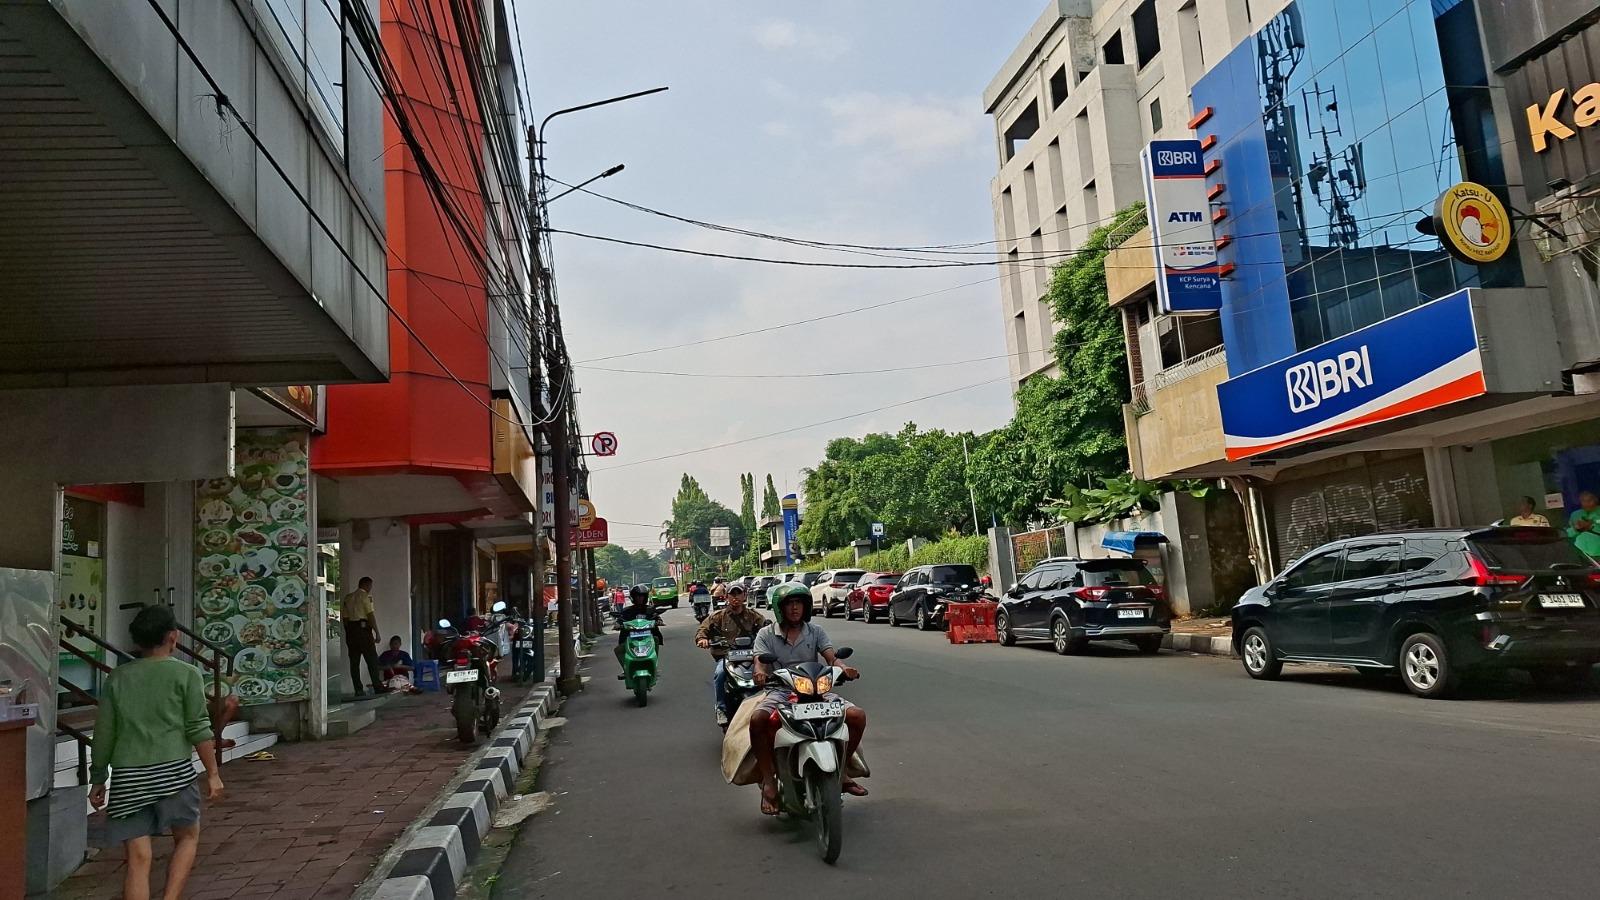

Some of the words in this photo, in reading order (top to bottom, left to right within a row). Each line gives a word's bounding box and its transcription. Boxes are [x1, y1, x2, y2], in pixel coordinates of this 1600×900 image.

[1173, 151, 1197, 165] BRI
[1168, 211, 1203, 223] ATM
[1193, 275, 1211, 284] Surya
[1316, 345, 1374, 400] BRI
[601, 437, 613, 452] P
